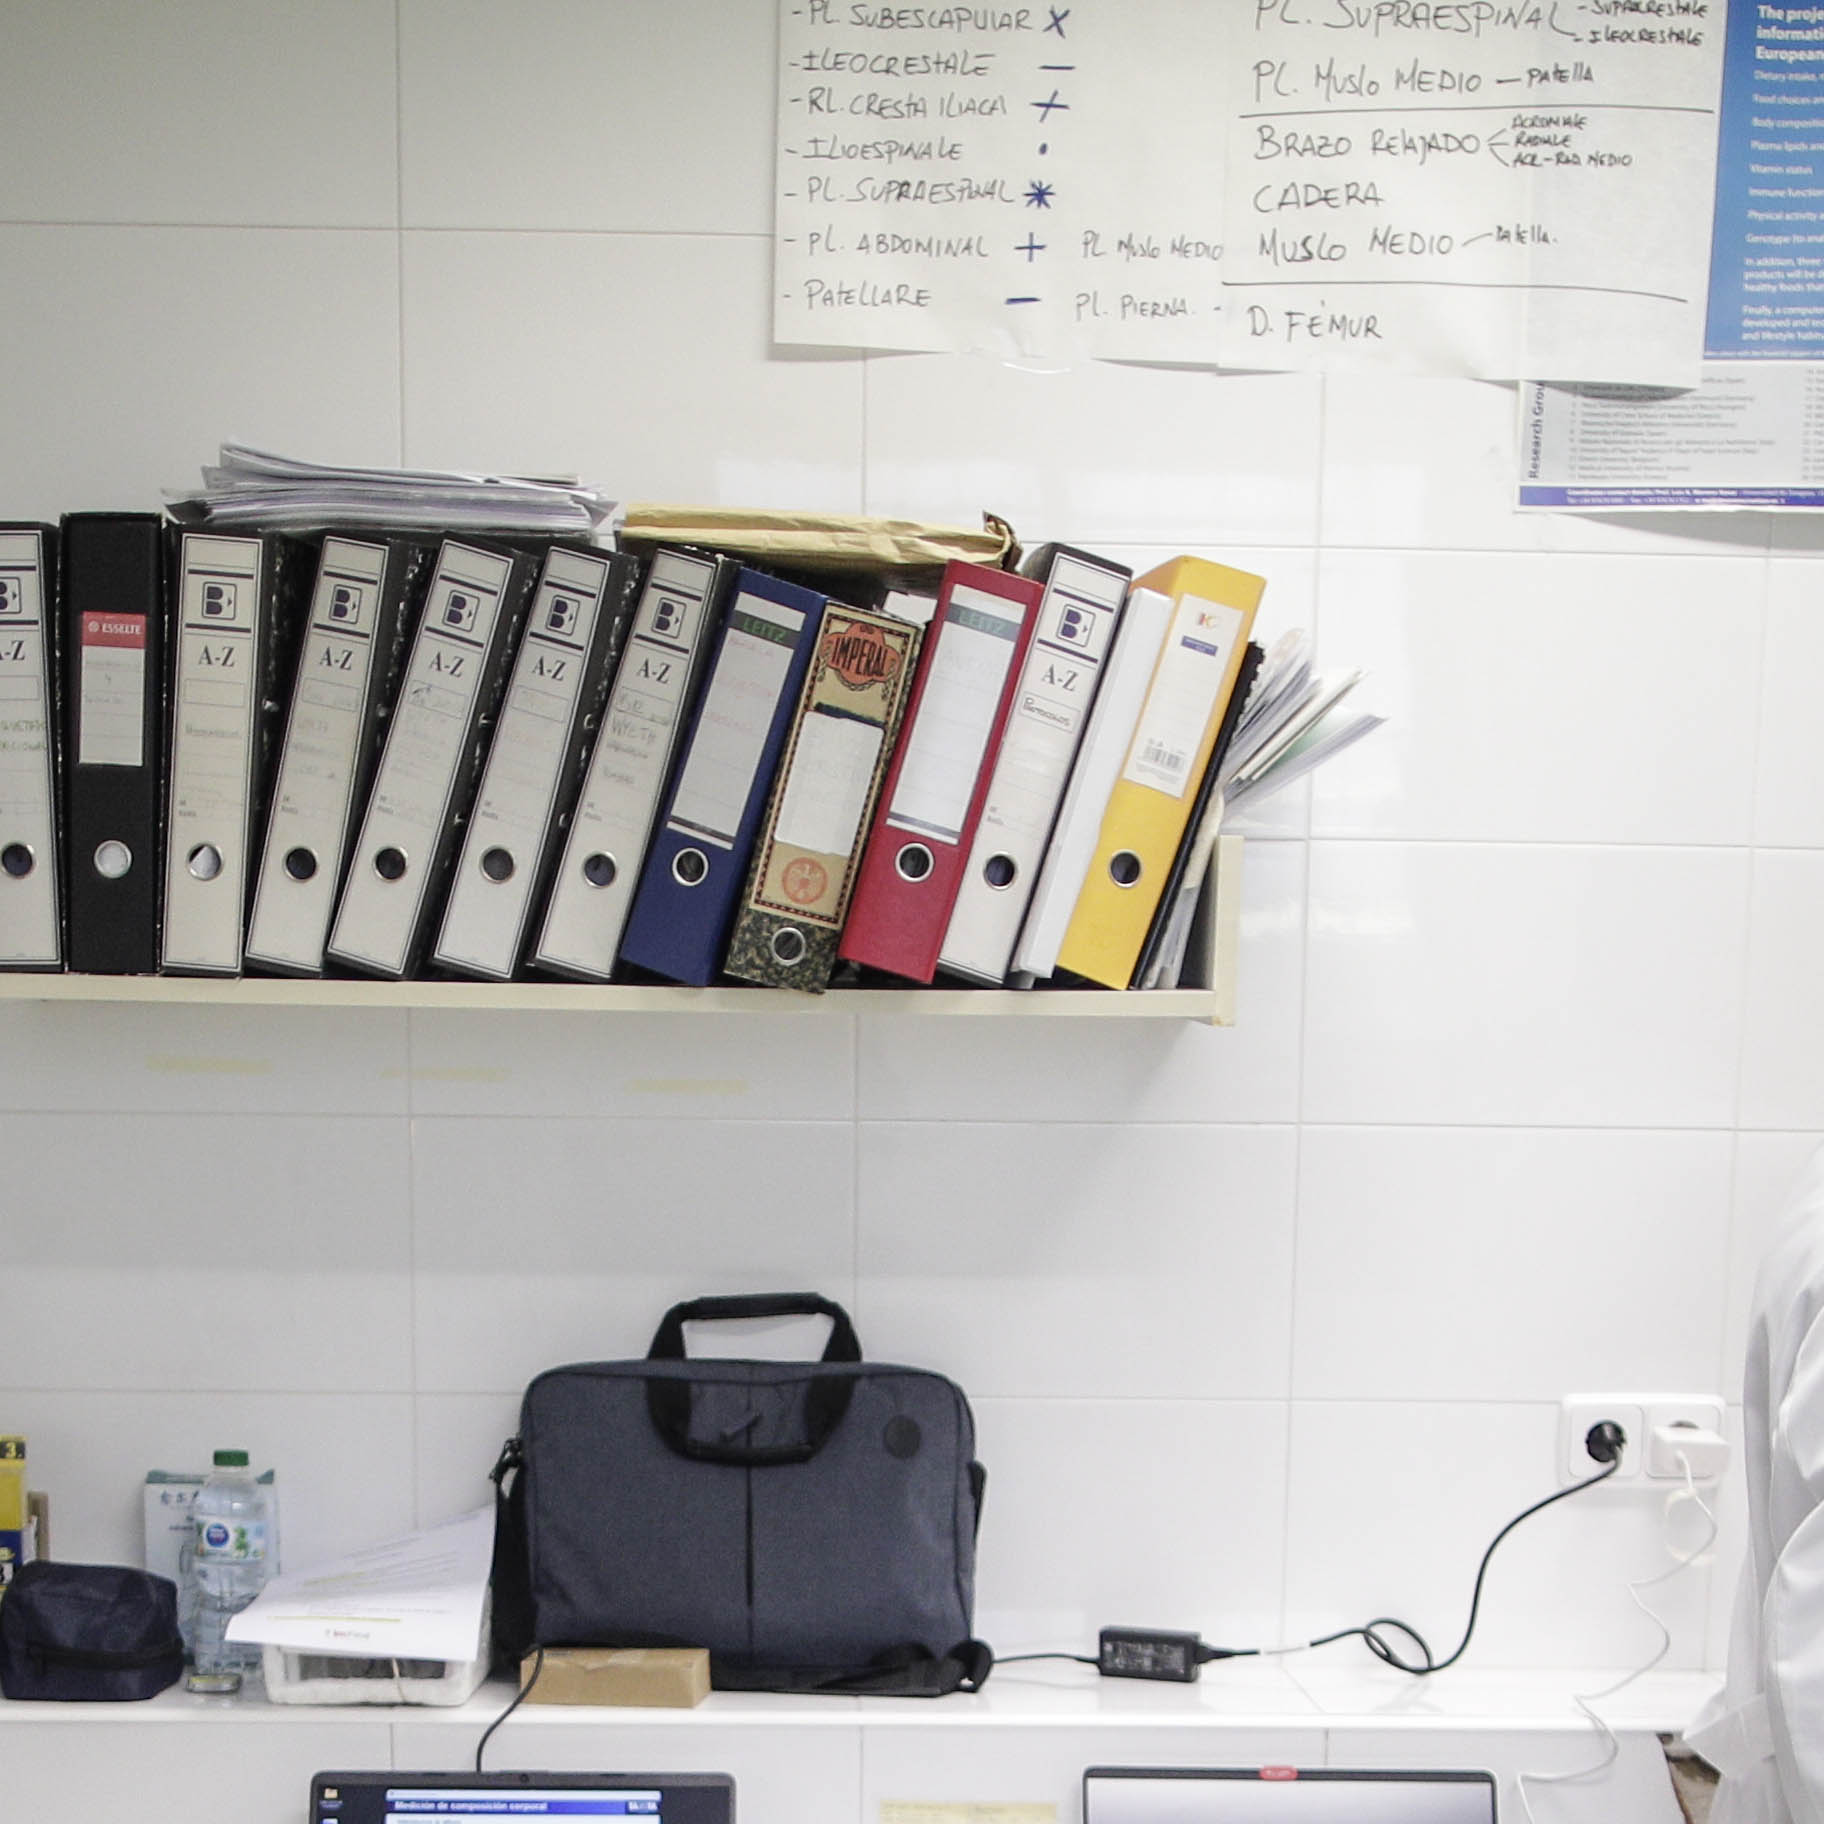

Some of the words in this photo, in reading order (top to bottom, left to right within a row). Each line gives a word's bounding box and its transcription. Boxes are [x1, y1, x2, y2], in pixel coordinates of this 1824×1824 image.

[1757, 5, 1785, 21] The
[1755, 45, 1824, 64] European
[1253, 181, 1384, 214] CADERA
[856, 232, 989, 258] ABDOMINAL
[102, 622, 142, 636] ESSELTE
[742, 618, 787, 643] LEITZ
[198, 645, 235, 667] A-Z
[319, 646, 354, 671] A-Z
[429, 651, 465, 678] A-Z
[531, 655, 567, 682] A-Z
[635, 657, 672, 684] A-Z
[1041, 663, 1080, 692] A-Z
